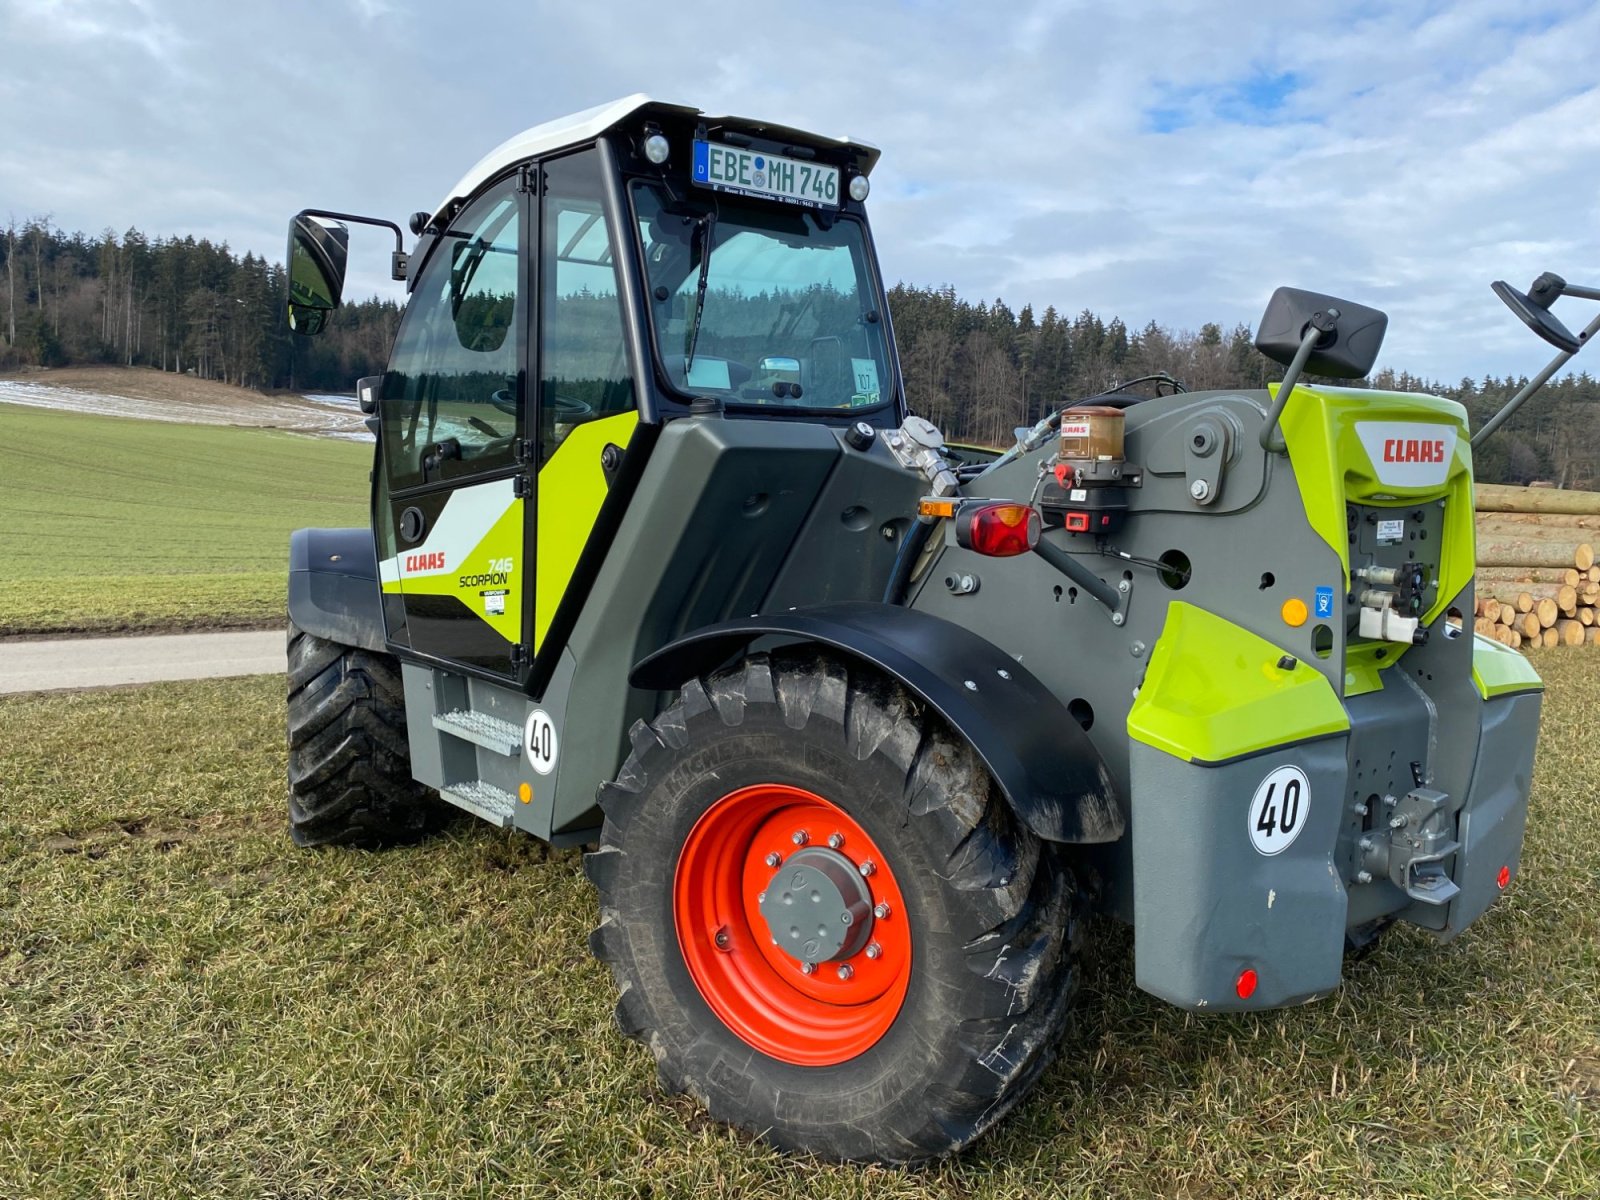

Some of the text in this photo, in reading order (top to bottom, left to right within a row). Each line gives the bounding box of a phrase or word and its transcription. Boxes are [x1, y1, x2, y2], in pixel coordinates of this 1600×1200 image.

[698, 164, 705, 174] D
[709, 148, 752, 186] EBE
[768, 159, 795, 194] MH
[800, 166, 836, 200] 746
[1383, 439, 1445, 463] CLAAS
[406, 552, 445, 572] CLAAS
[488, 557, 514, 574] 746
[459, 572, 508, 588] SCORPION
[530, 719, 551, 762] 40
[1256, 778, 1301, 838] 40
